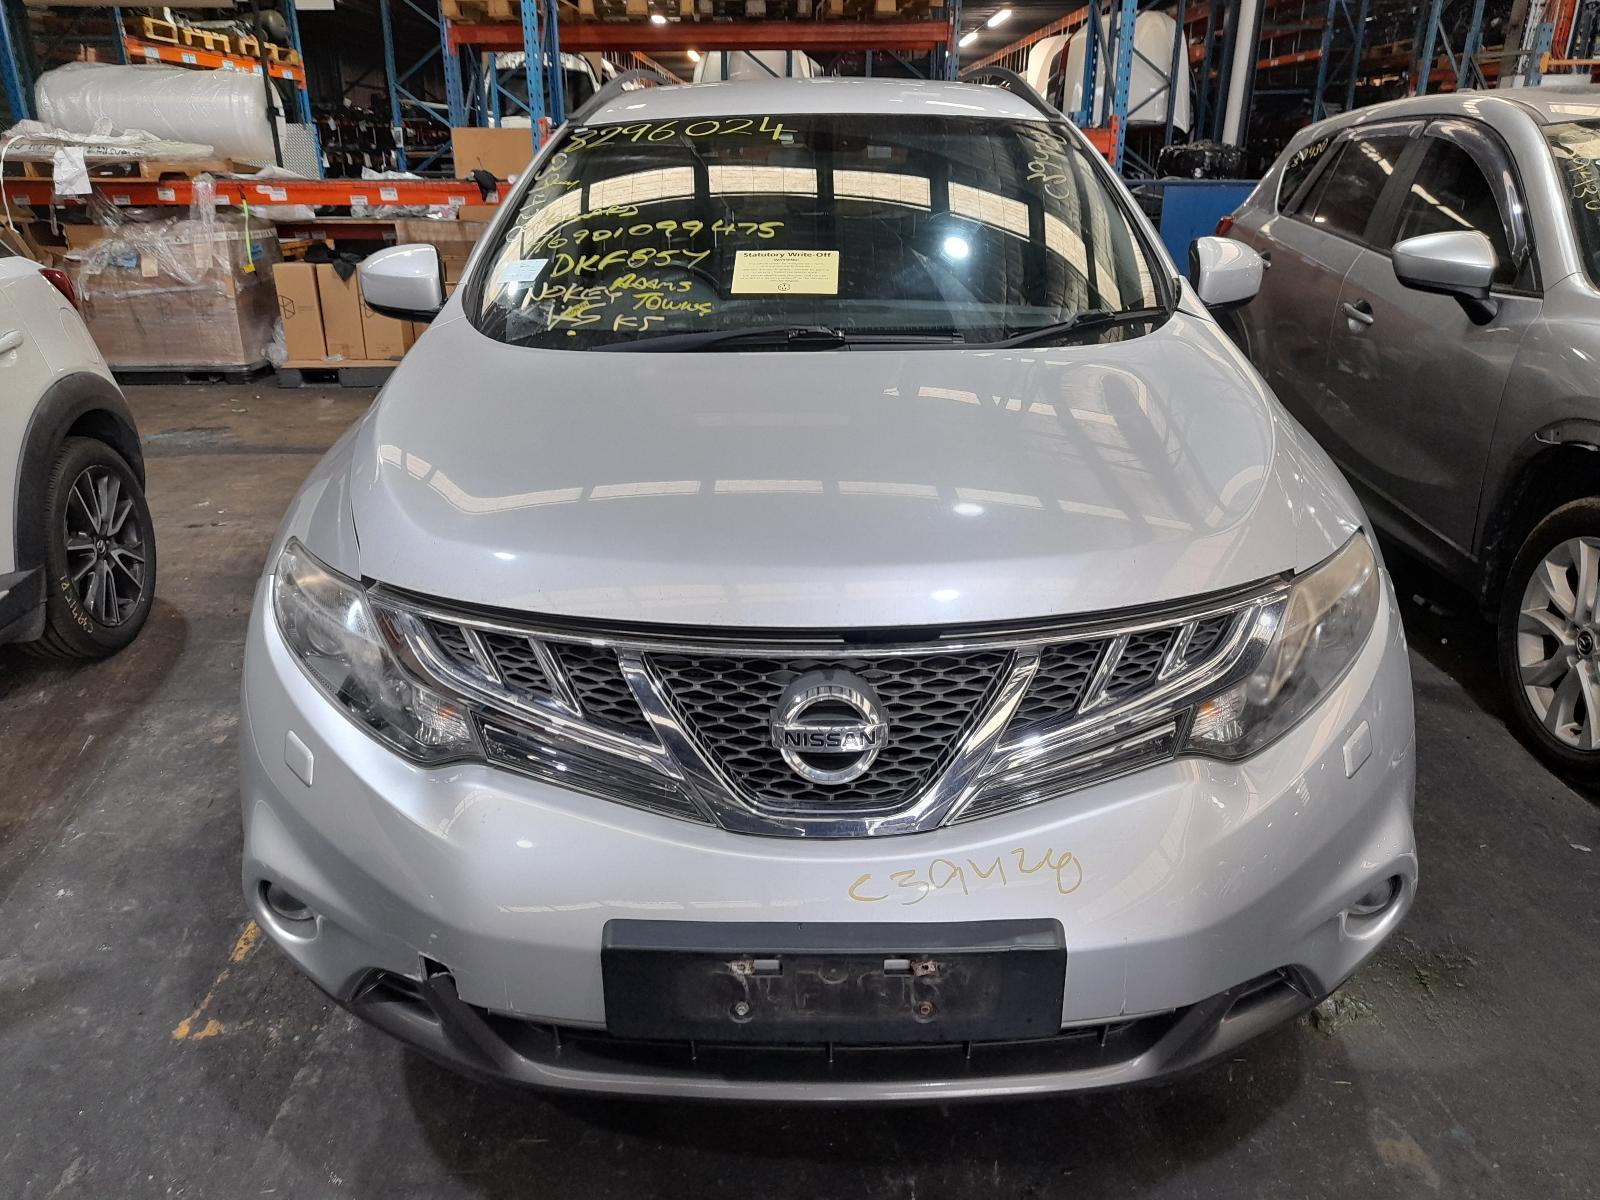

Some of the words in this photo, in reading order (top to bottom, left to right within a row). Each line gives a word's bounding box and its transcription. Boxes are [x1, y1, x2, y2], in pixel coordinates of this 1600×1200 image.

[563, 115, 799, 153] 8296024
[743, 252, 785, 260] Statutory
[784, 732, 876, 747] NISSAN
